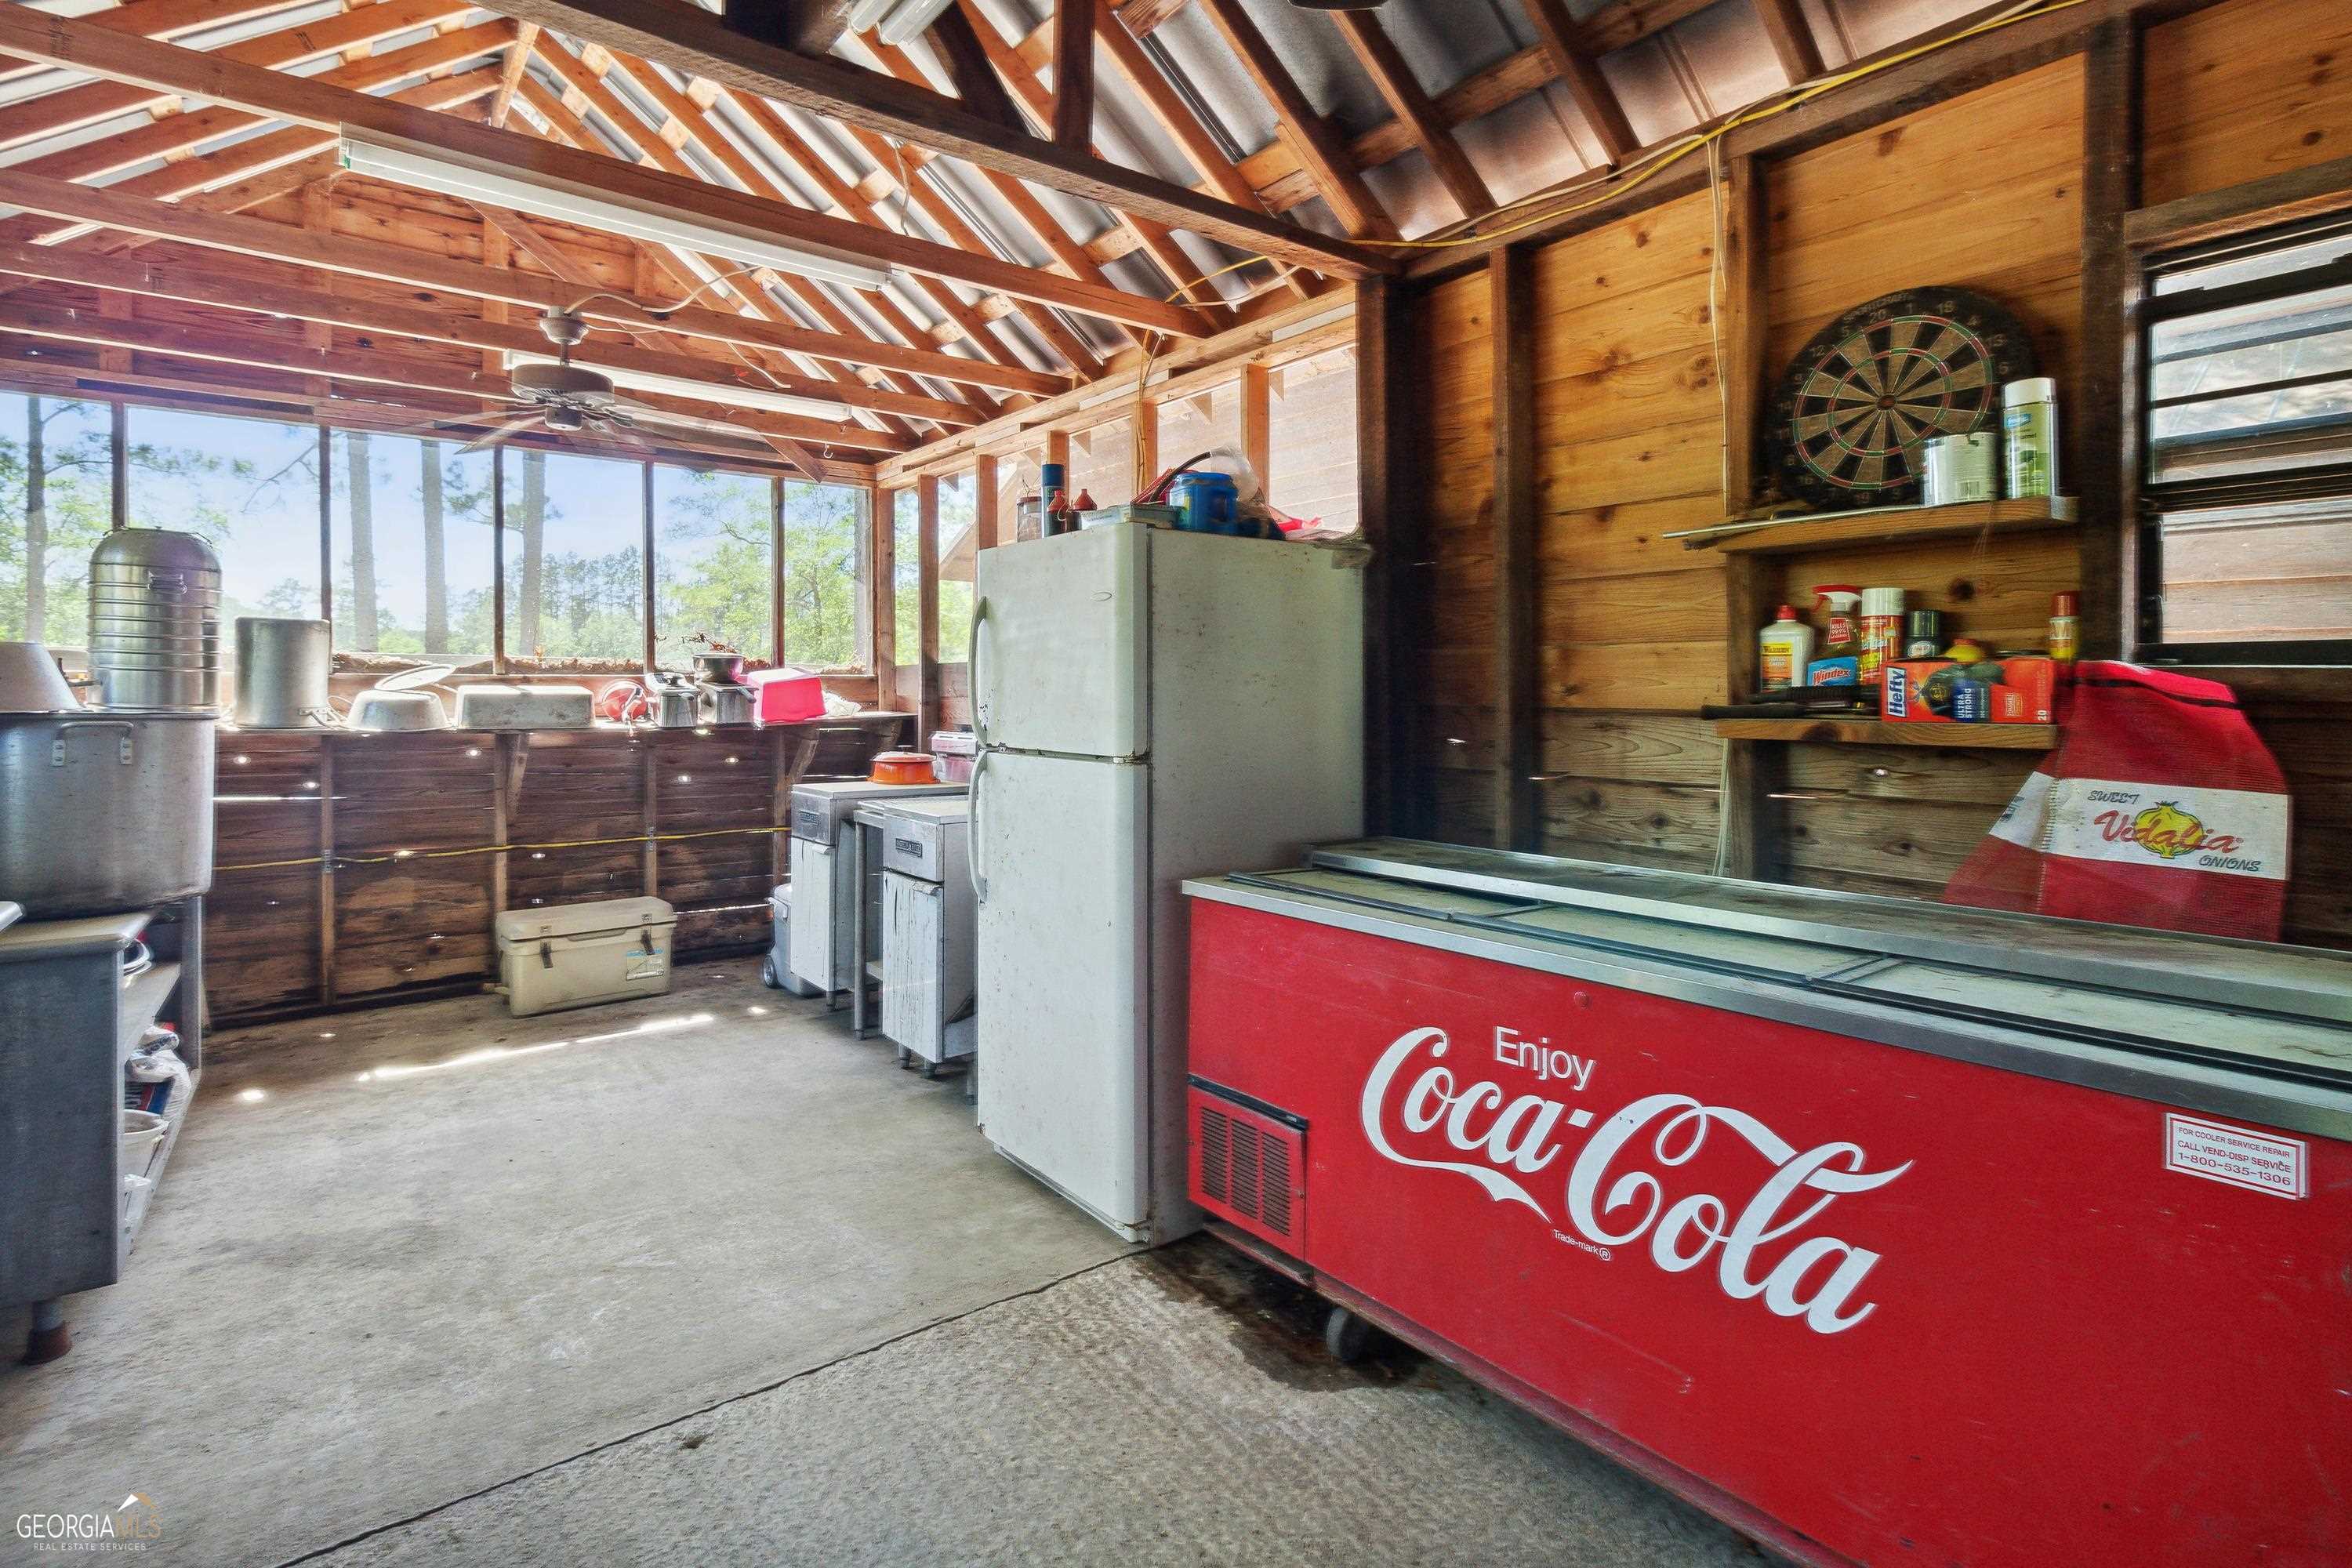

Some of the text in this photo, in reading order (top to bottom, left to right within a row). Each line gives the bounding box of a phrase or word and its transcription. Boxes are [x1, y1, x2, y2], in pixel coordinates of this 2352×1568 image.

[1813, 669, 1851, 686] Windex
[1889, 670, 1907, 715] Hefty
[1964, 688, 1973, 719] STRONG
[2037, 710, 2048, 721] 20
[2087, 789, 2140, 805] SWEET
[2093, 809, 2242, 854] Vidalia
[2198, 855, 2263, 873] ONIONS
[1495, 1025, 1596, 1091] Enjoy
[2178, 1127, 2291, 1159] FOR COOLER SERVICE REPAIR
[2178, 1140, 2292, 1174] CALL VEND-DISP SERVICE
[1361, 1026, 1915, 1335] Coca-Cola
[2178, 1152, 2292, 1186] 1-800-535-1306
